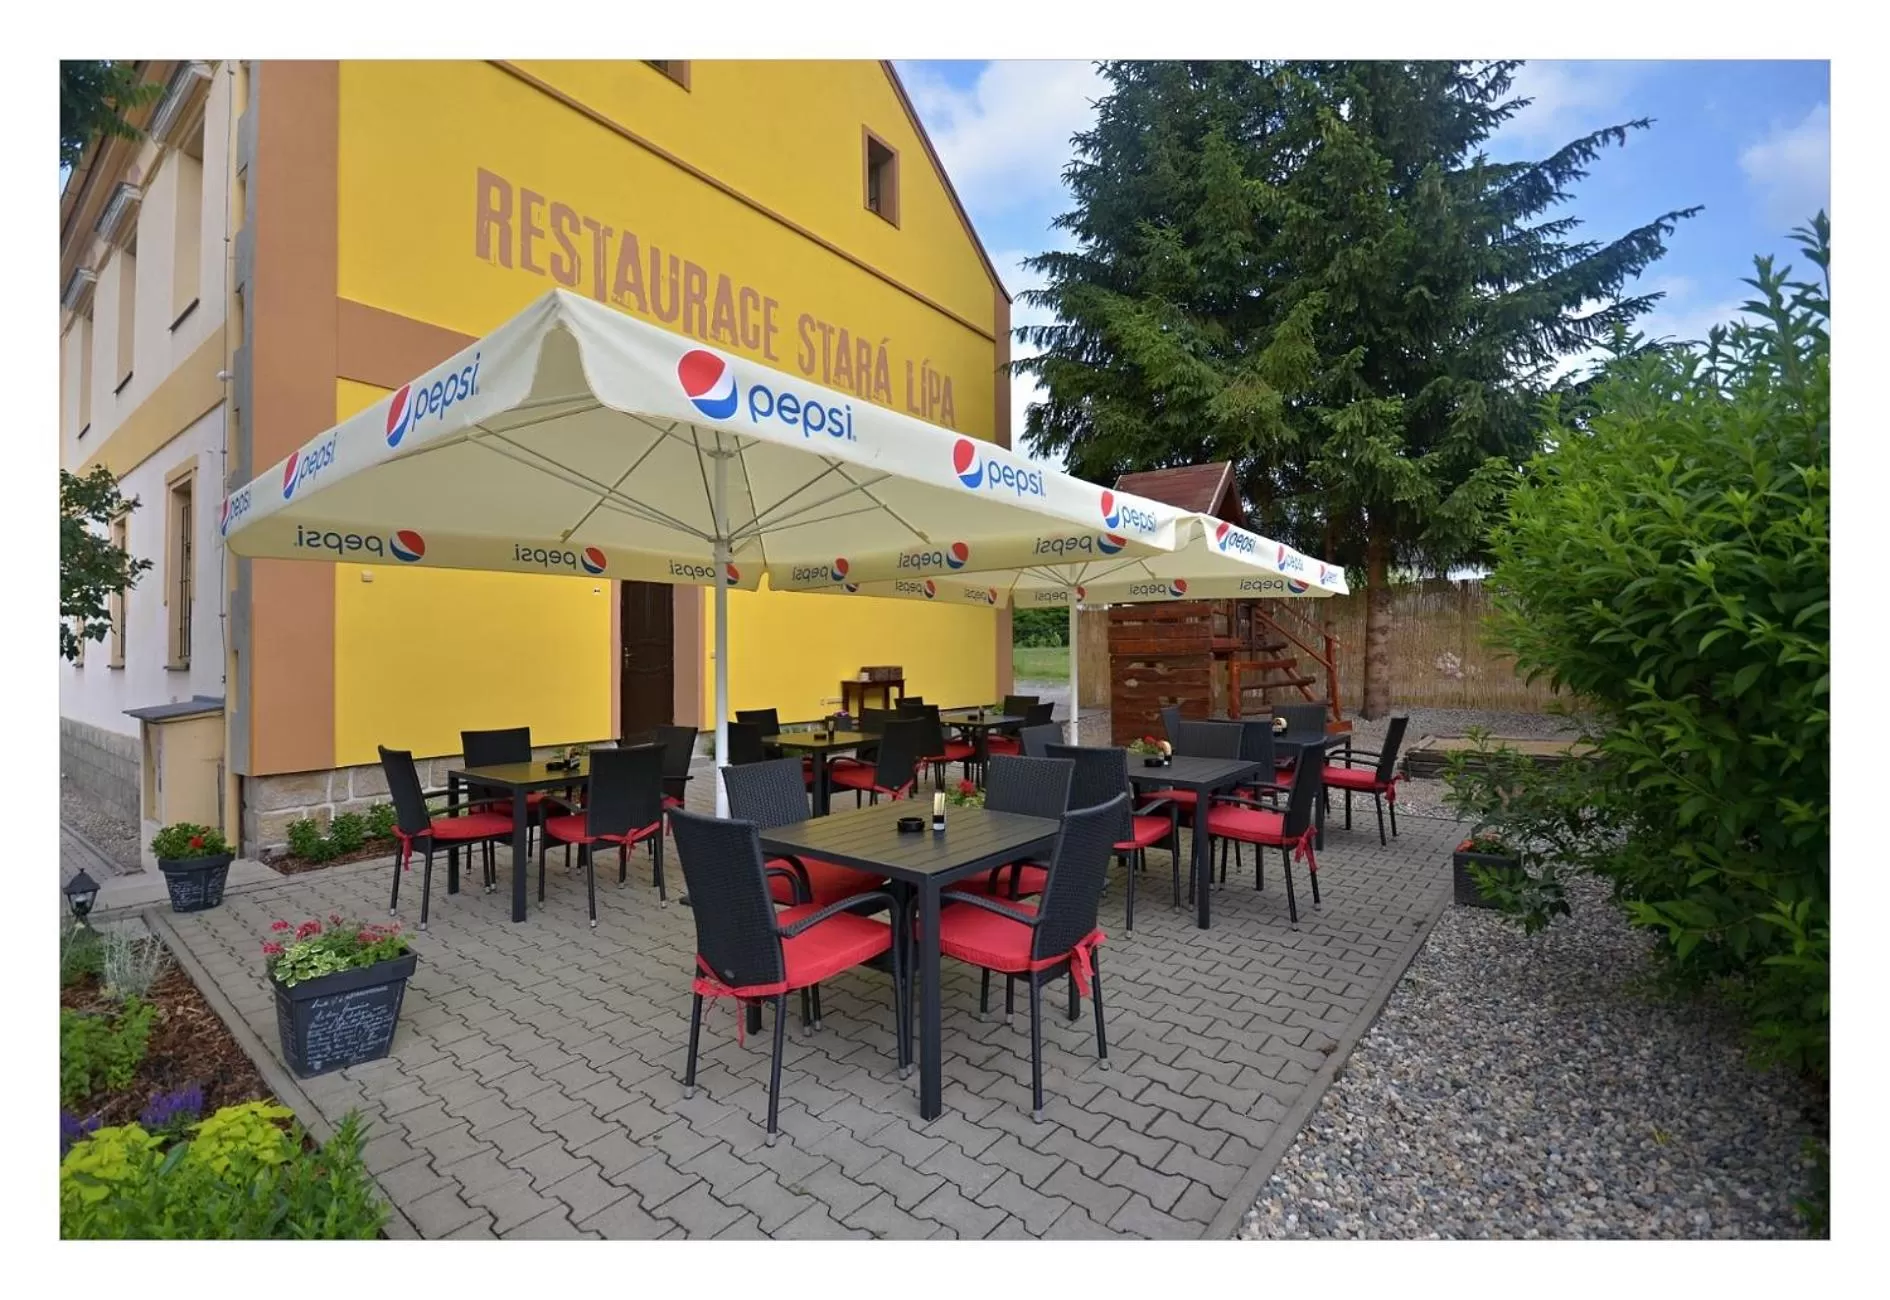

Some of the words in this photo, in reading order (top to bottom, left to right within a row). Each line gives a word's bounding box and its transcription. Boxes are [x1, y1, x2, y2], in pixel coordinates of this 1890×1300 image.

[475, 167, 779, 362] RESTAURACE
[797, 314, 892, 405] STARÁ
[905, 358, 957, 428] LÍPA
[412, 352, 481, 431] pepsi
[748, 385, 853, 442] pepsi
[297, 432, 337, 488] pepsi
[988, 459, 1043, 496] pepsi
[1122, 506, 1157, 533] pepsi
[1229, 530, 1255, 554] pepsi
